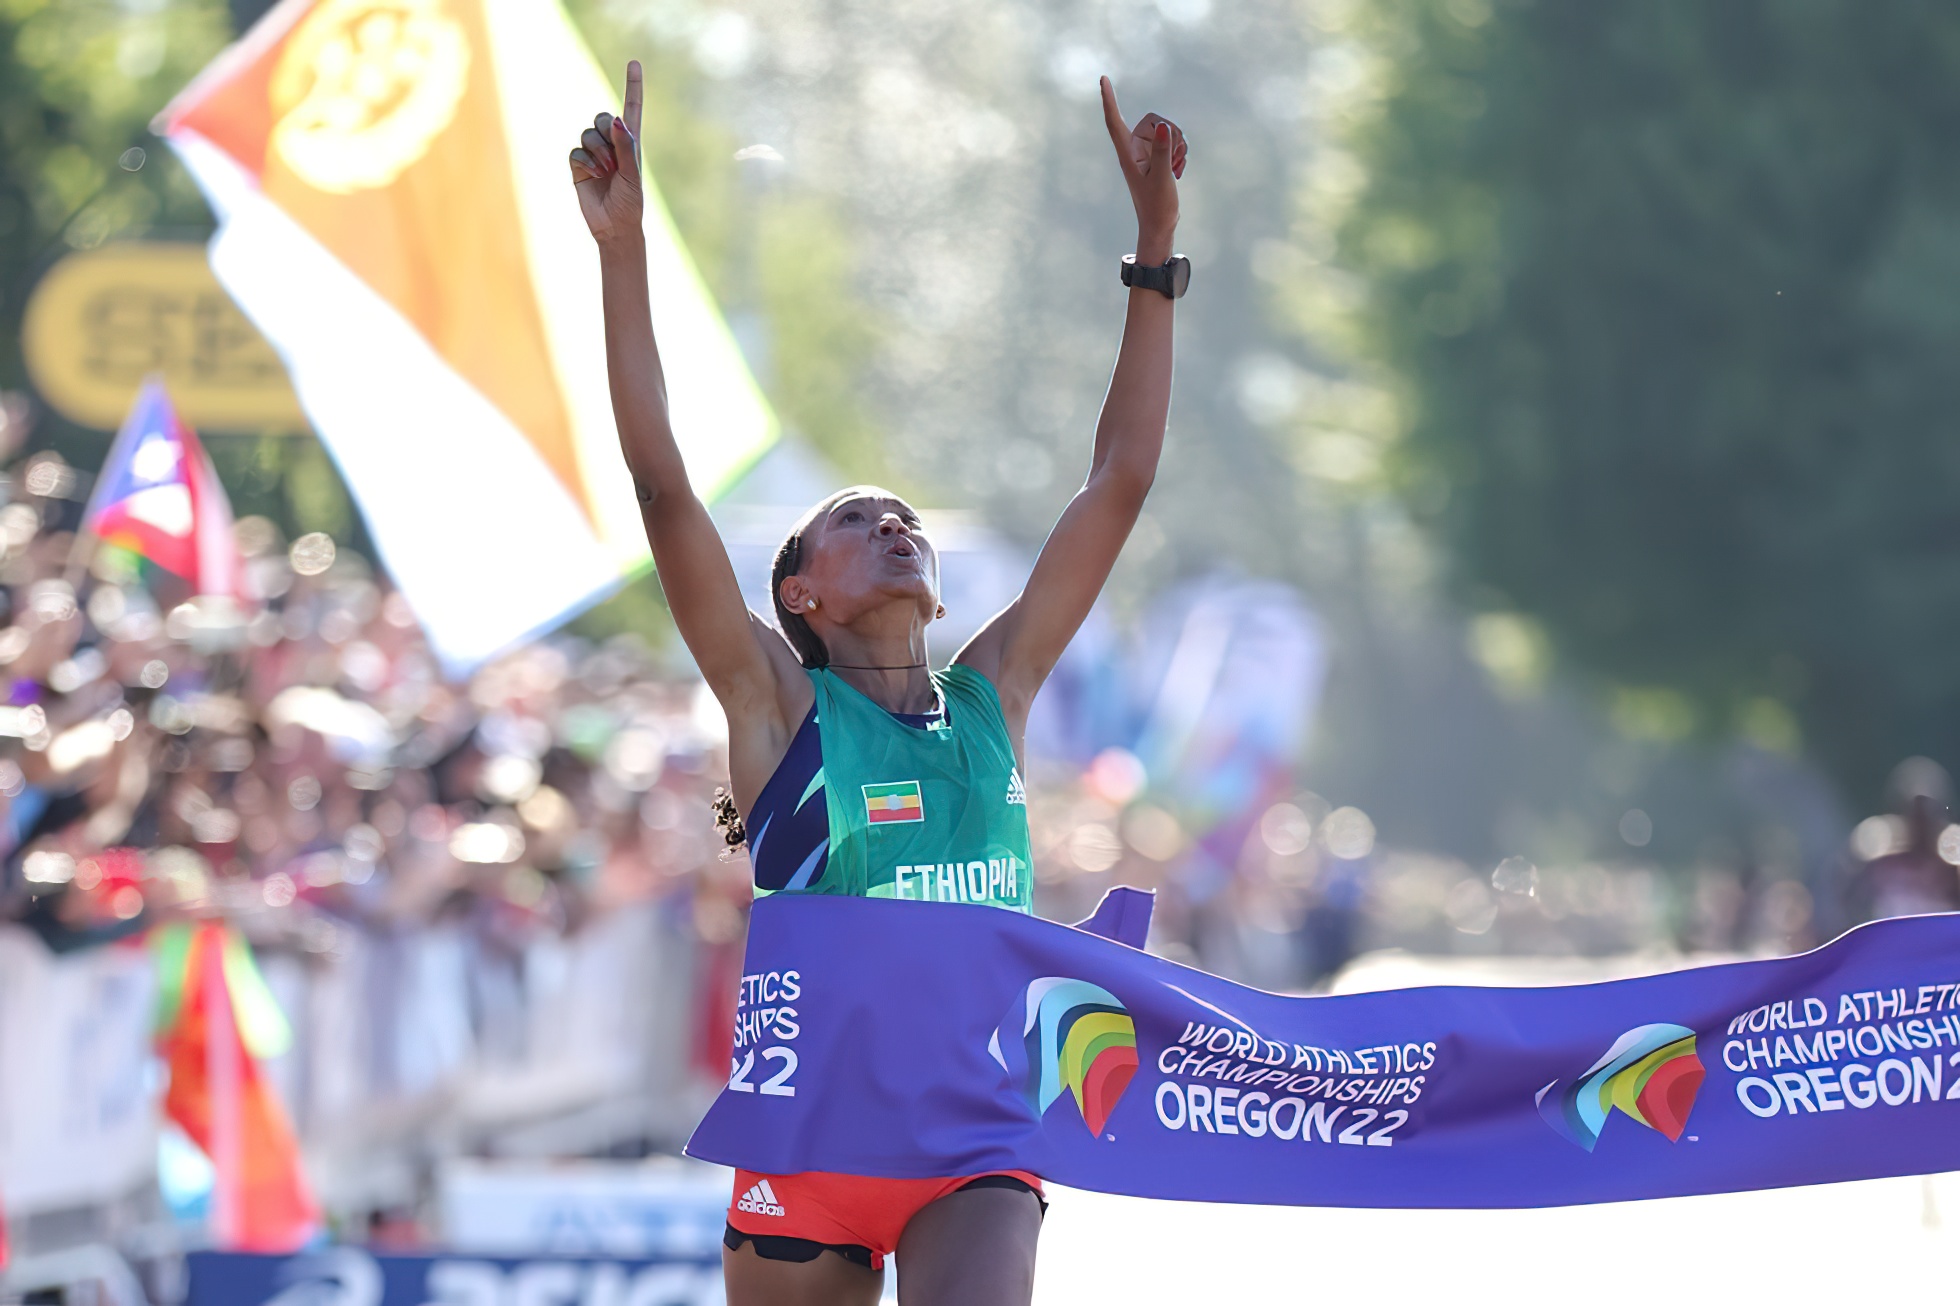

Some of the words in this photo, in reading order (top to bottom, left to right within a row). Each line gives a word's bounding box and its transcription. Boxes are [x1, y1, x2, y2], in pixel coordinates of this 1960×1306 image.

[895, 857, 1018, 902] ETHIOPIA
[1727, 997, 1828, 1036] WORLD
[1837, 983, 1960, 1024] ATHLETI
[1178, 1021, 1287, 1066] WORLD
[1290, 1042, 1437, 1075] ATHLETICS
[1158, 1046, 1425, 1105] CHAMPIONSHIPS
[737, 1199, 785, 1217] adidas
